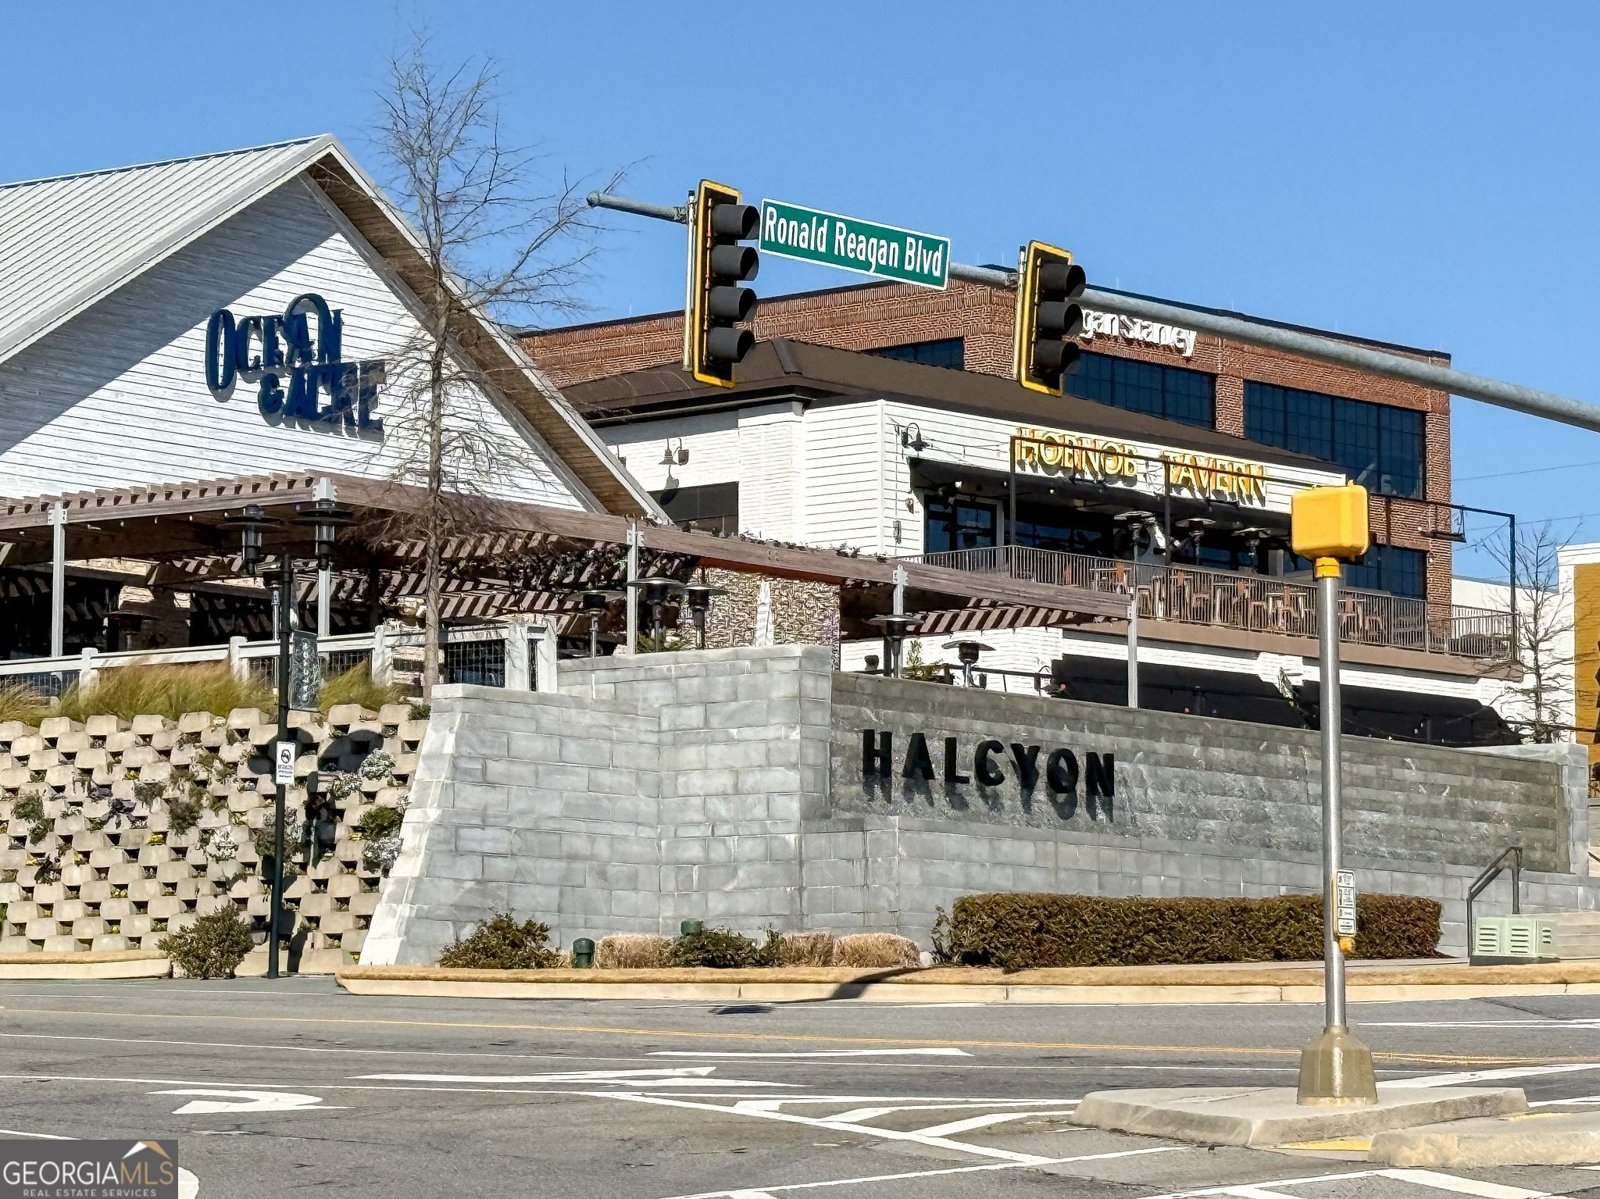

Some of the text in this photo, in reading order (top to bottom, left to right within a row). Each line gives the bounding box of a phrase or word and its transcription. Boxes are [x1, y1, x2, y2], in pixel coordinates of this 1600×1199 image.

[765, 206, 943, 277] Ronald Reagan Blvd
[205, 293, 344, 390] OCEAN
[1080, 309, 1119, 339] gan
[258, 361, 386, 431] & ACRE
[1016, 427, 1266, 497] HOBNOB TAVERN
[863, 729, 1115, 797] HALCYON
